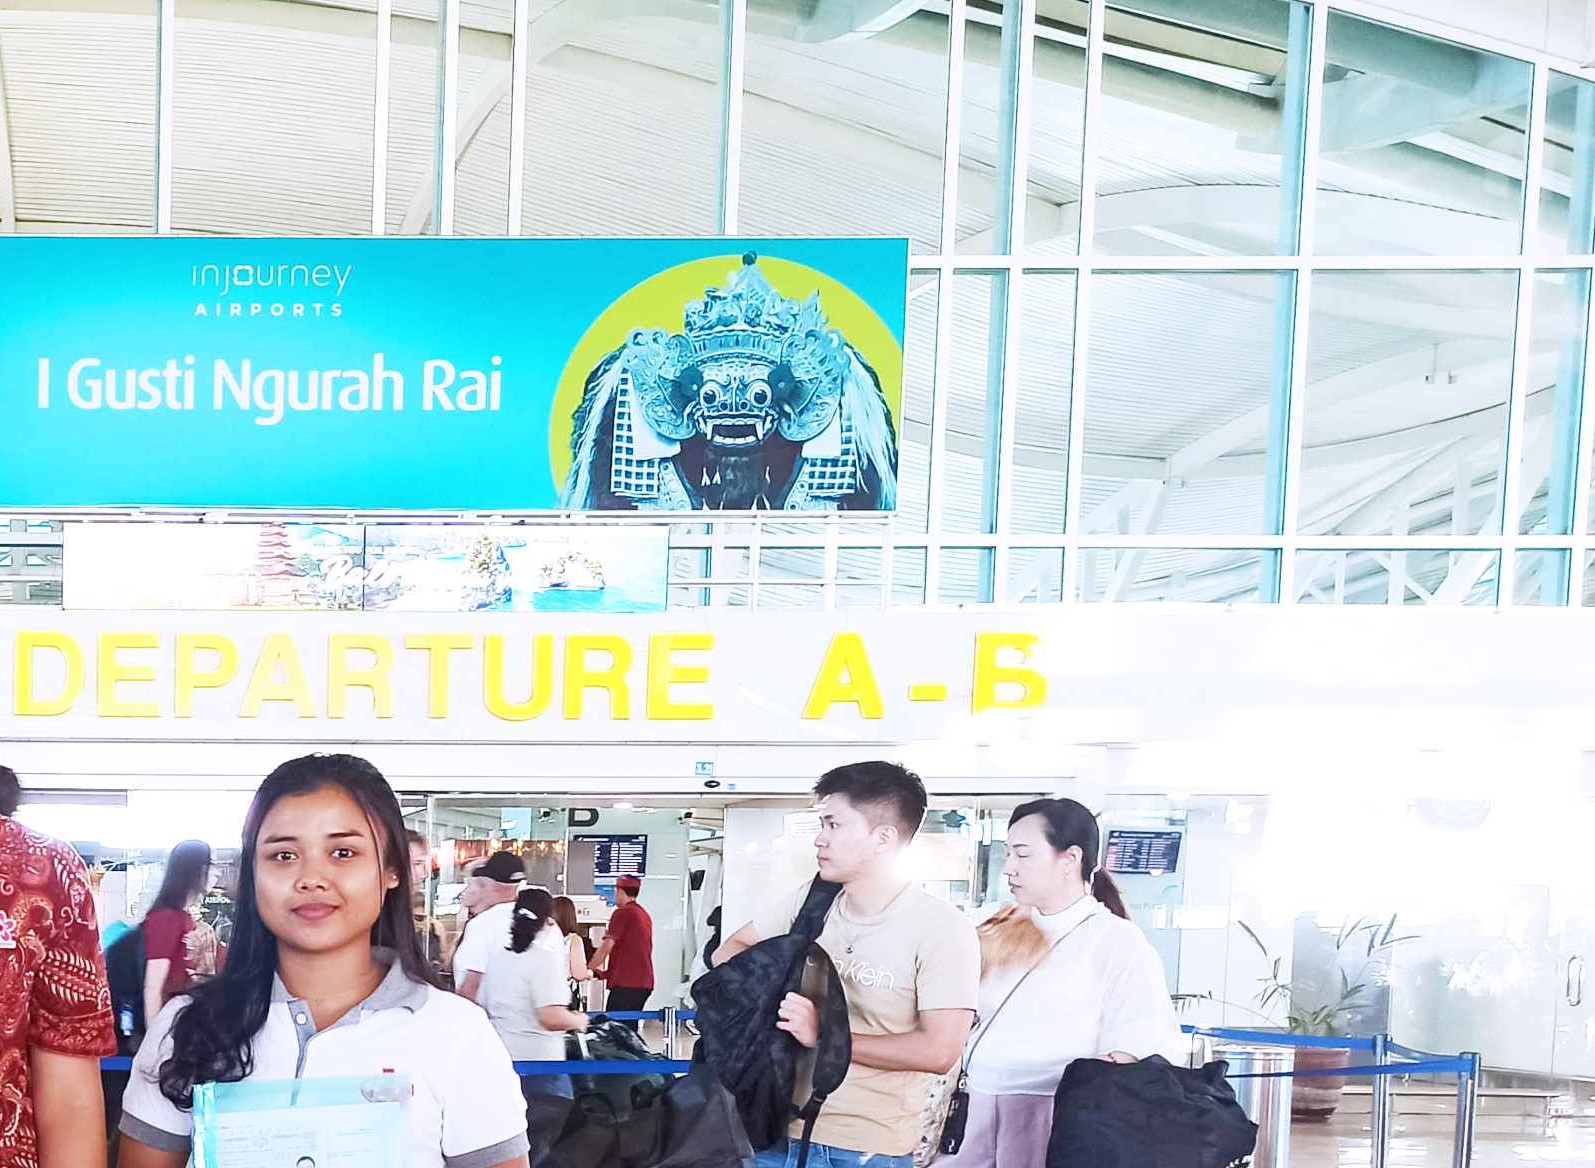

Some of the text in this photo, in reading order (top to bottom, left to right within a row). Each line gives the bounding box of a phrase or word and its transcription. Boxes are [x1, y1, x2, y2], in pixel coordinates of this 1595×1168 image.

[192, 264, 352, 296] injourney
[194, 302, 343, 317] AIRPORTS
[38, 352, 502, 426] I Gusti Ngurah Rai
[12, 630, 715, 722] DEPARTURE
[844, 958, 895, 991] Klein
